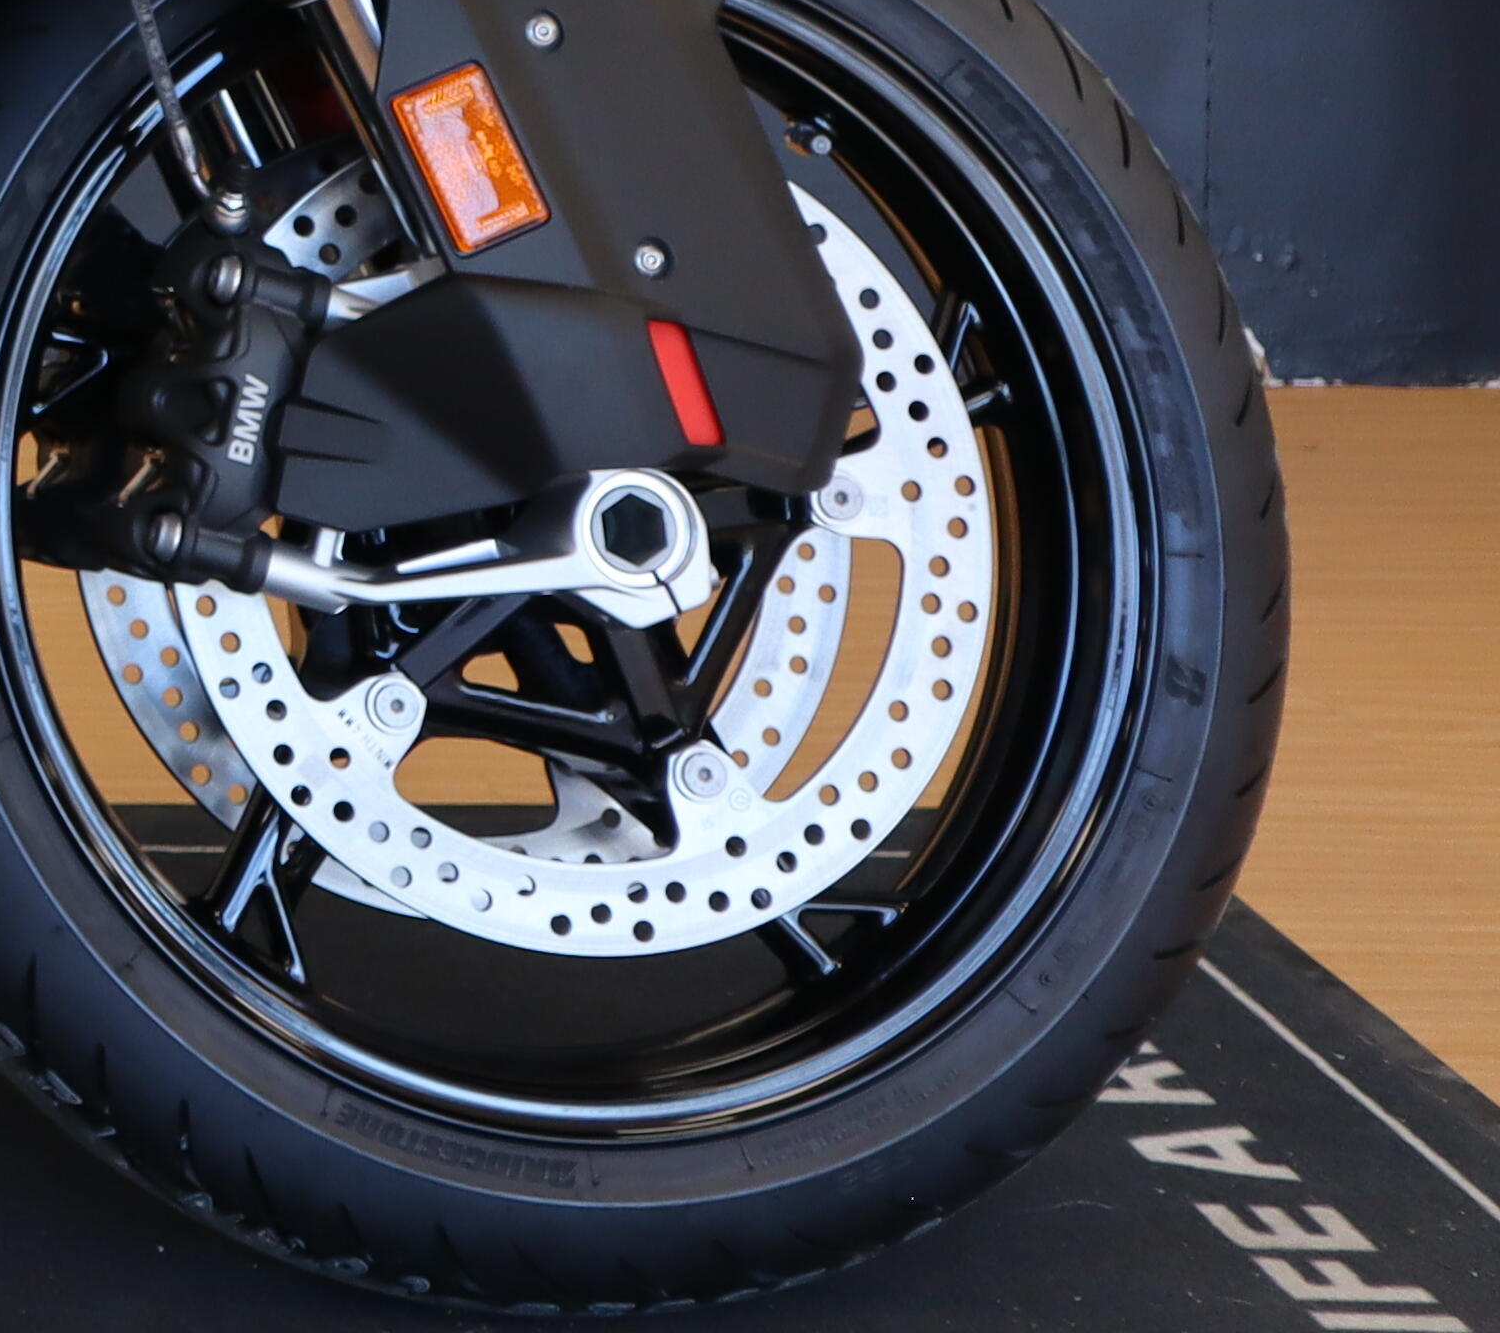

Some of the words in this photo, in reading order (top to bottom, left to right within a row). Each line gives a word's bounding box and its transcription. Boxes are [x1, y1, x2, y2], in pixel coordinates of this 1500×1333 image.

[227, 374, 271, 466] BMW
[333, 1099, 578, 1190] BRIDGESTONE
[1128, 1124, 1301, 1181] A
